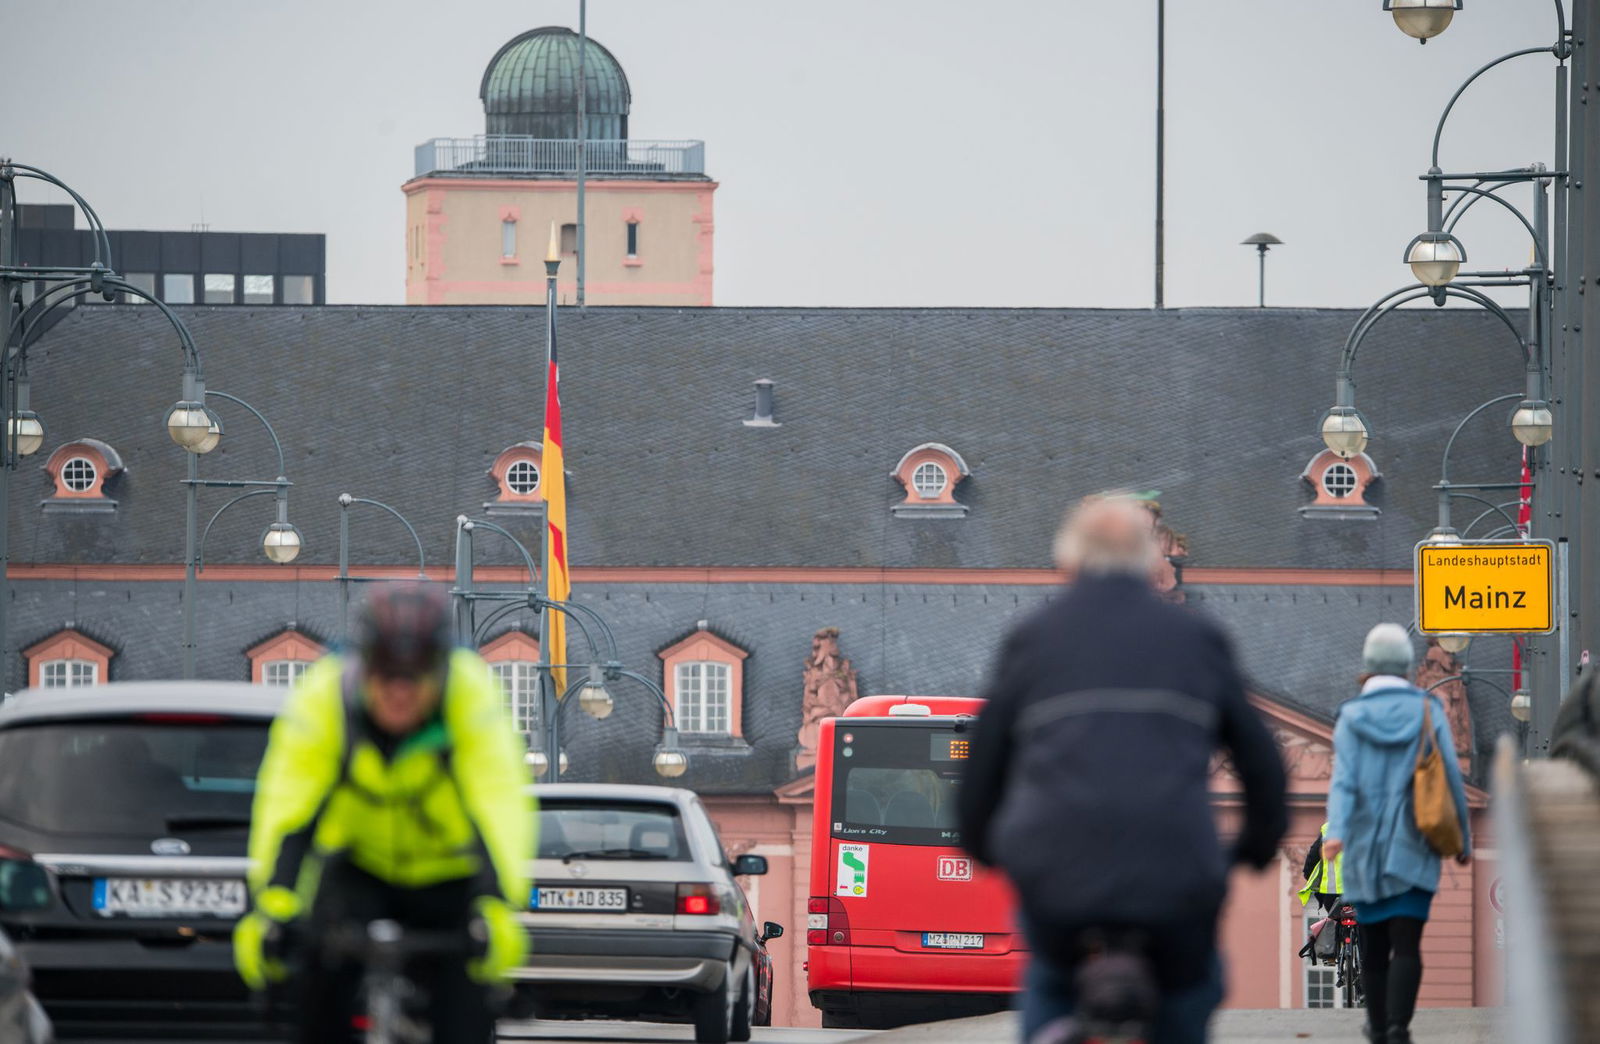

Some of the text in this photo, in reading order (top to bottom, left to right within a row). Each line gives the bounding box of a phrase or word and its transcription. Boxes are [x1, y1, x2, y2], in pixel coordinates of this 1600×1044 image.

[1428, 554, 1541, 568] Landeshauptstadt
[1445, 585, 1526, 609] Mainz
[941, 859, 969, 877] DB
[109, 879, 140, 903] KA
[160, 879, 173, 904] S
[538, 891, 566, 905] MTK
[577, 892, 594, 906] AD
[599, 892, 624, 906] 835
[928, 934, 942, 944] MZ
[964, 935, 983, 945] 217
